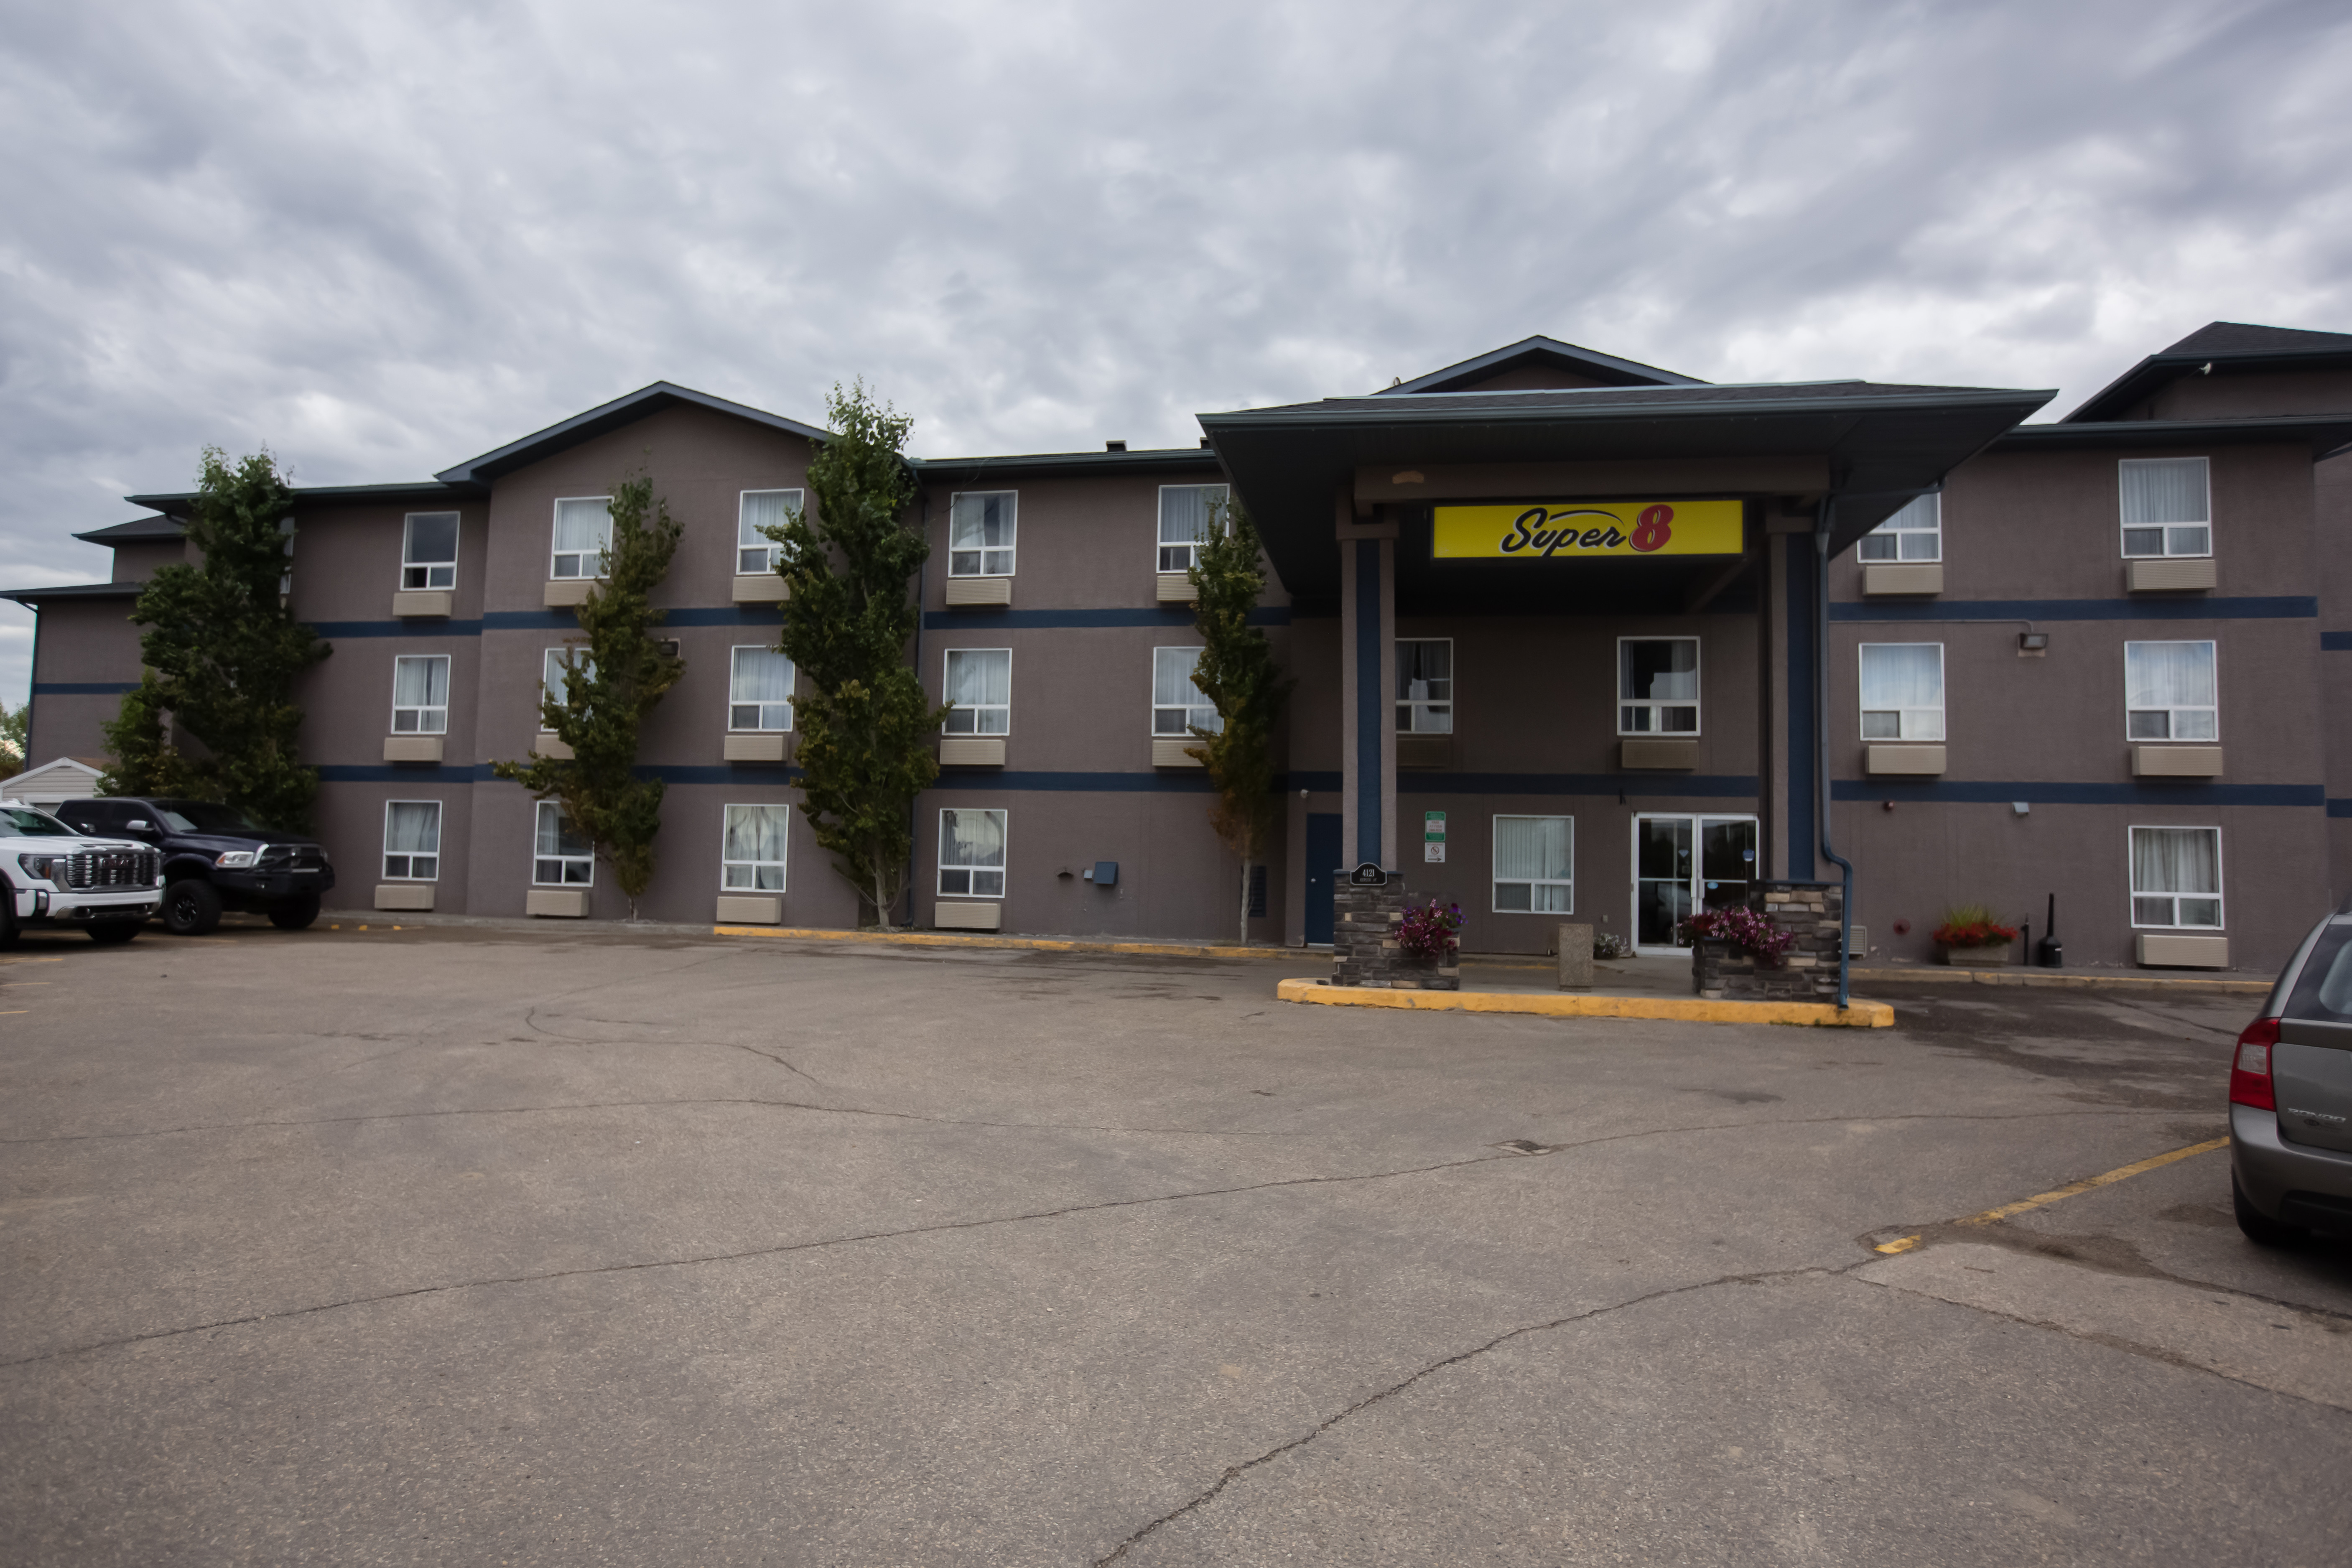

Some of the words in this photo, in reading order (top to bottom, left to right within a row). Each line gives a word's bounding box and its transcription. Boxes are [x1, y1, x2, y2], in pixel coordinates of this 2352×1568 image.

[1500, 507, 1626, 556] Super
[1629, 505, 1674, 552] 8
[2287, 1108, 2346, 1123] RONDO
